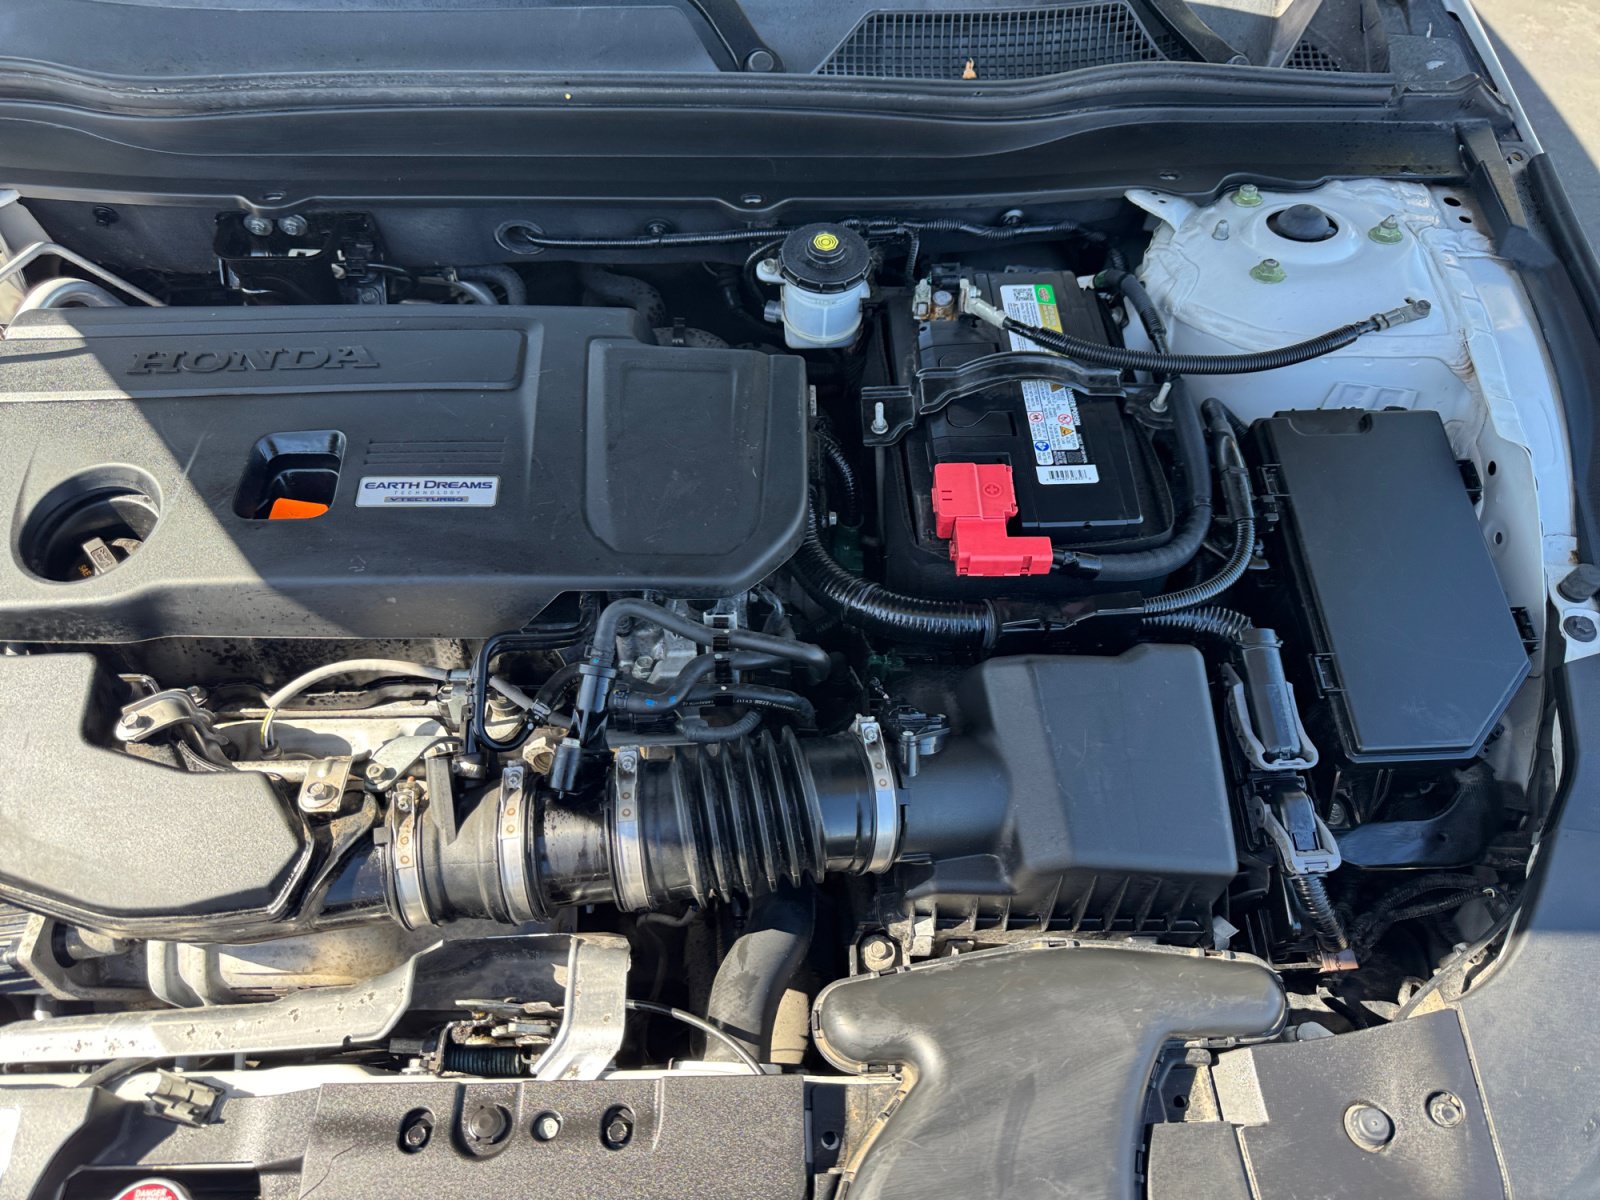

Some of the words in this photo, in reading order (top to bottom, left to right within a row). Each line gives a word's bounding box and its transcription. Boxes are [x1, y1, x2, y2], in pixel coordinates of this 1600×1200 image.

[126, 345, 380, 376] HONDA
[364, 481, 420, 490] EARTH
[135, 1188, 167, 1197] DANGER
